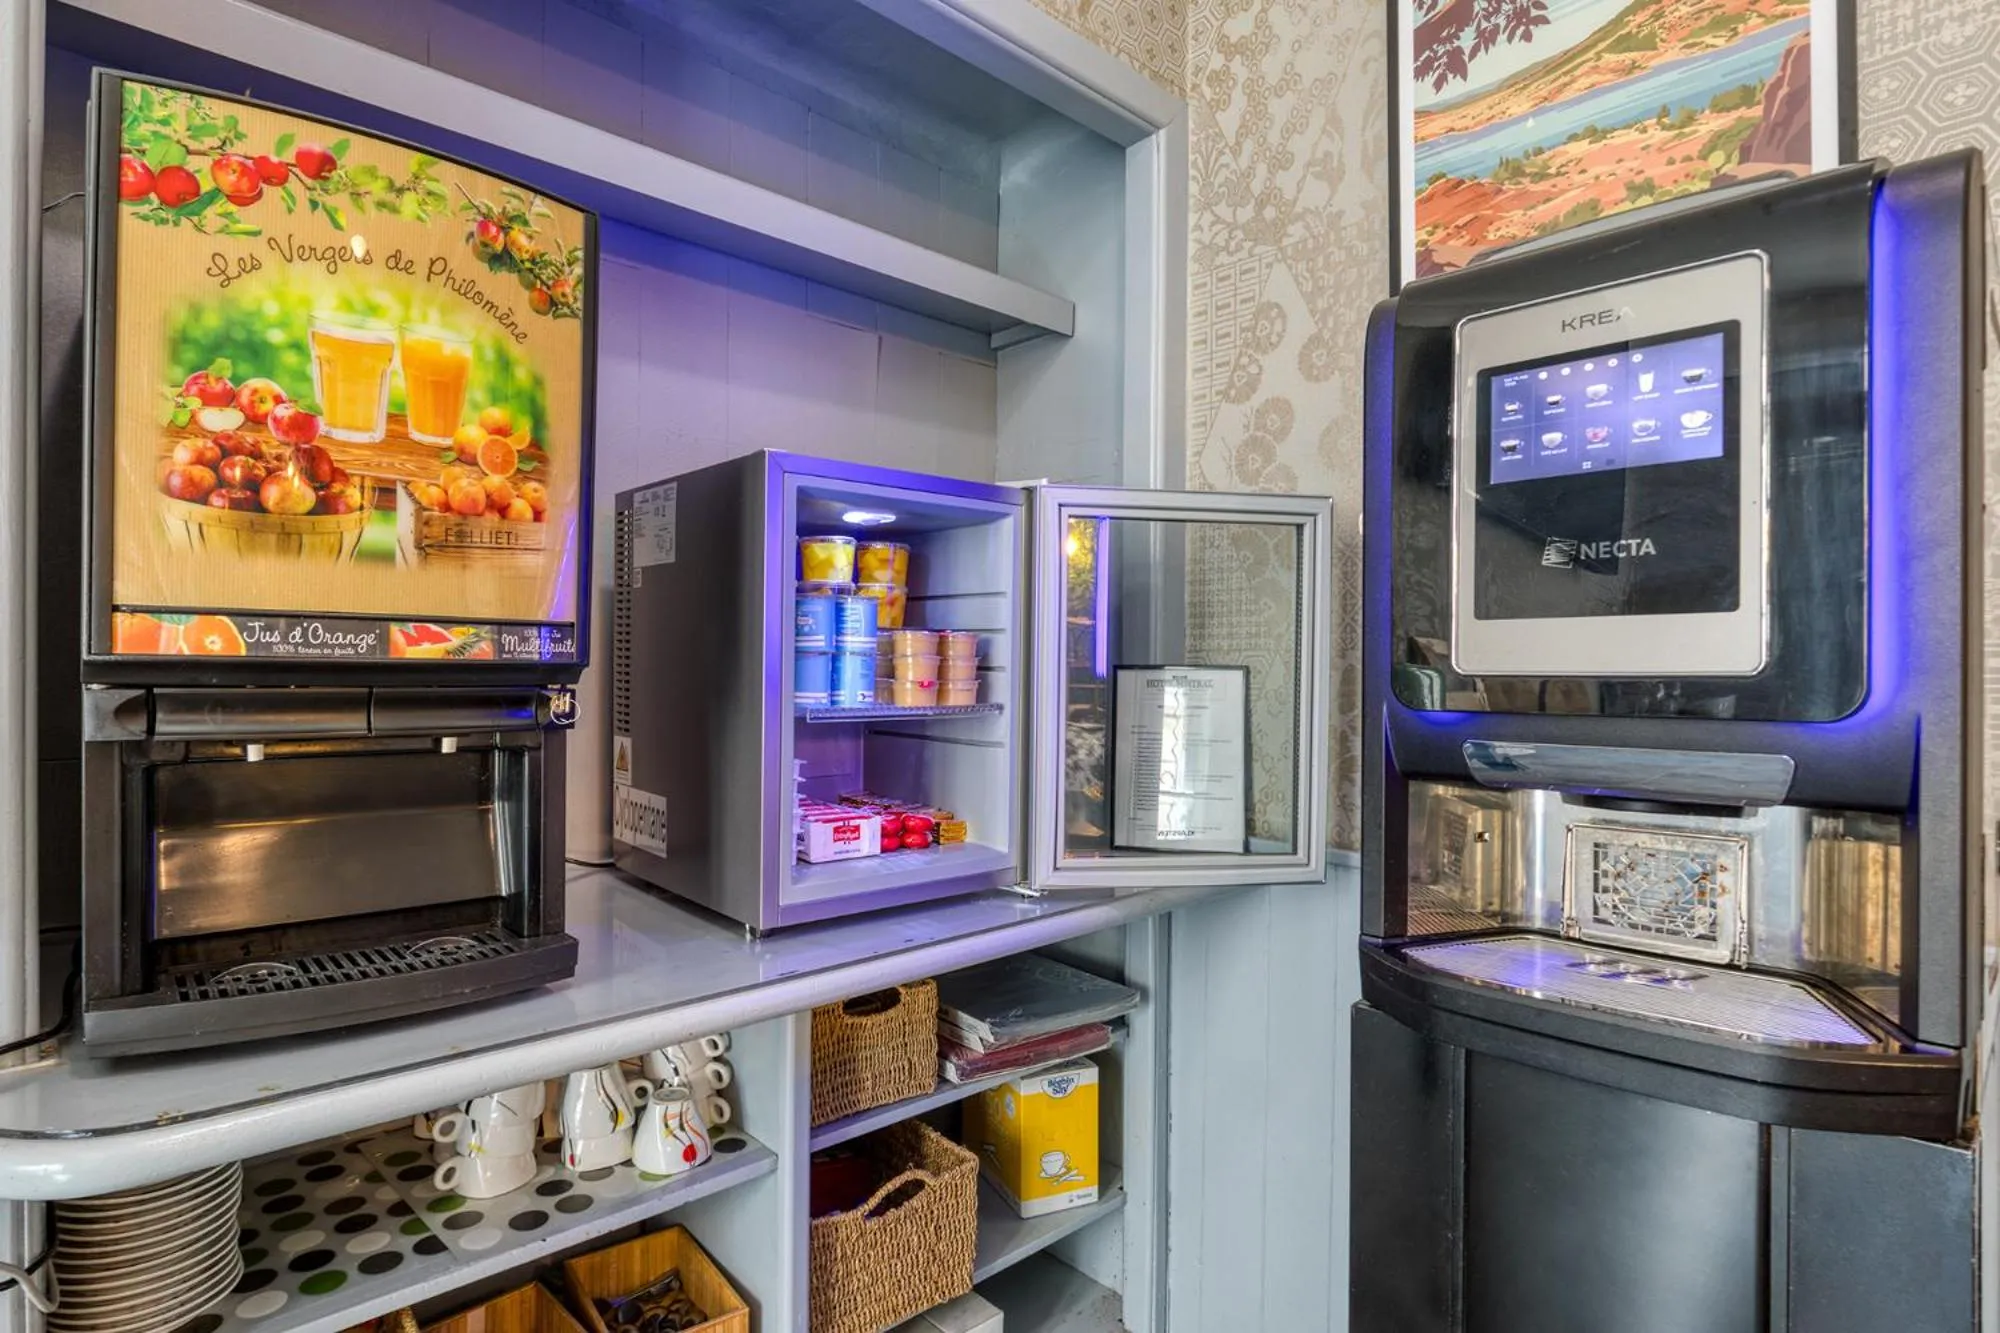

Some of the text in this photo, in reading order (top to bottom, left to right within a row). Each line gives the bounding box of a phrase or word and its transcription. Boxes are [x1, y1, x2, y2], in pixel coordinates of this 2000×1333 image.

[206, 252, 262, 289] Les
[386, 249, 416, 275] de
[426, 256, 528, 345] Philomène
[1580, 538, 1657, 560] NECTA
[243, 621, 281, 643] Jus
